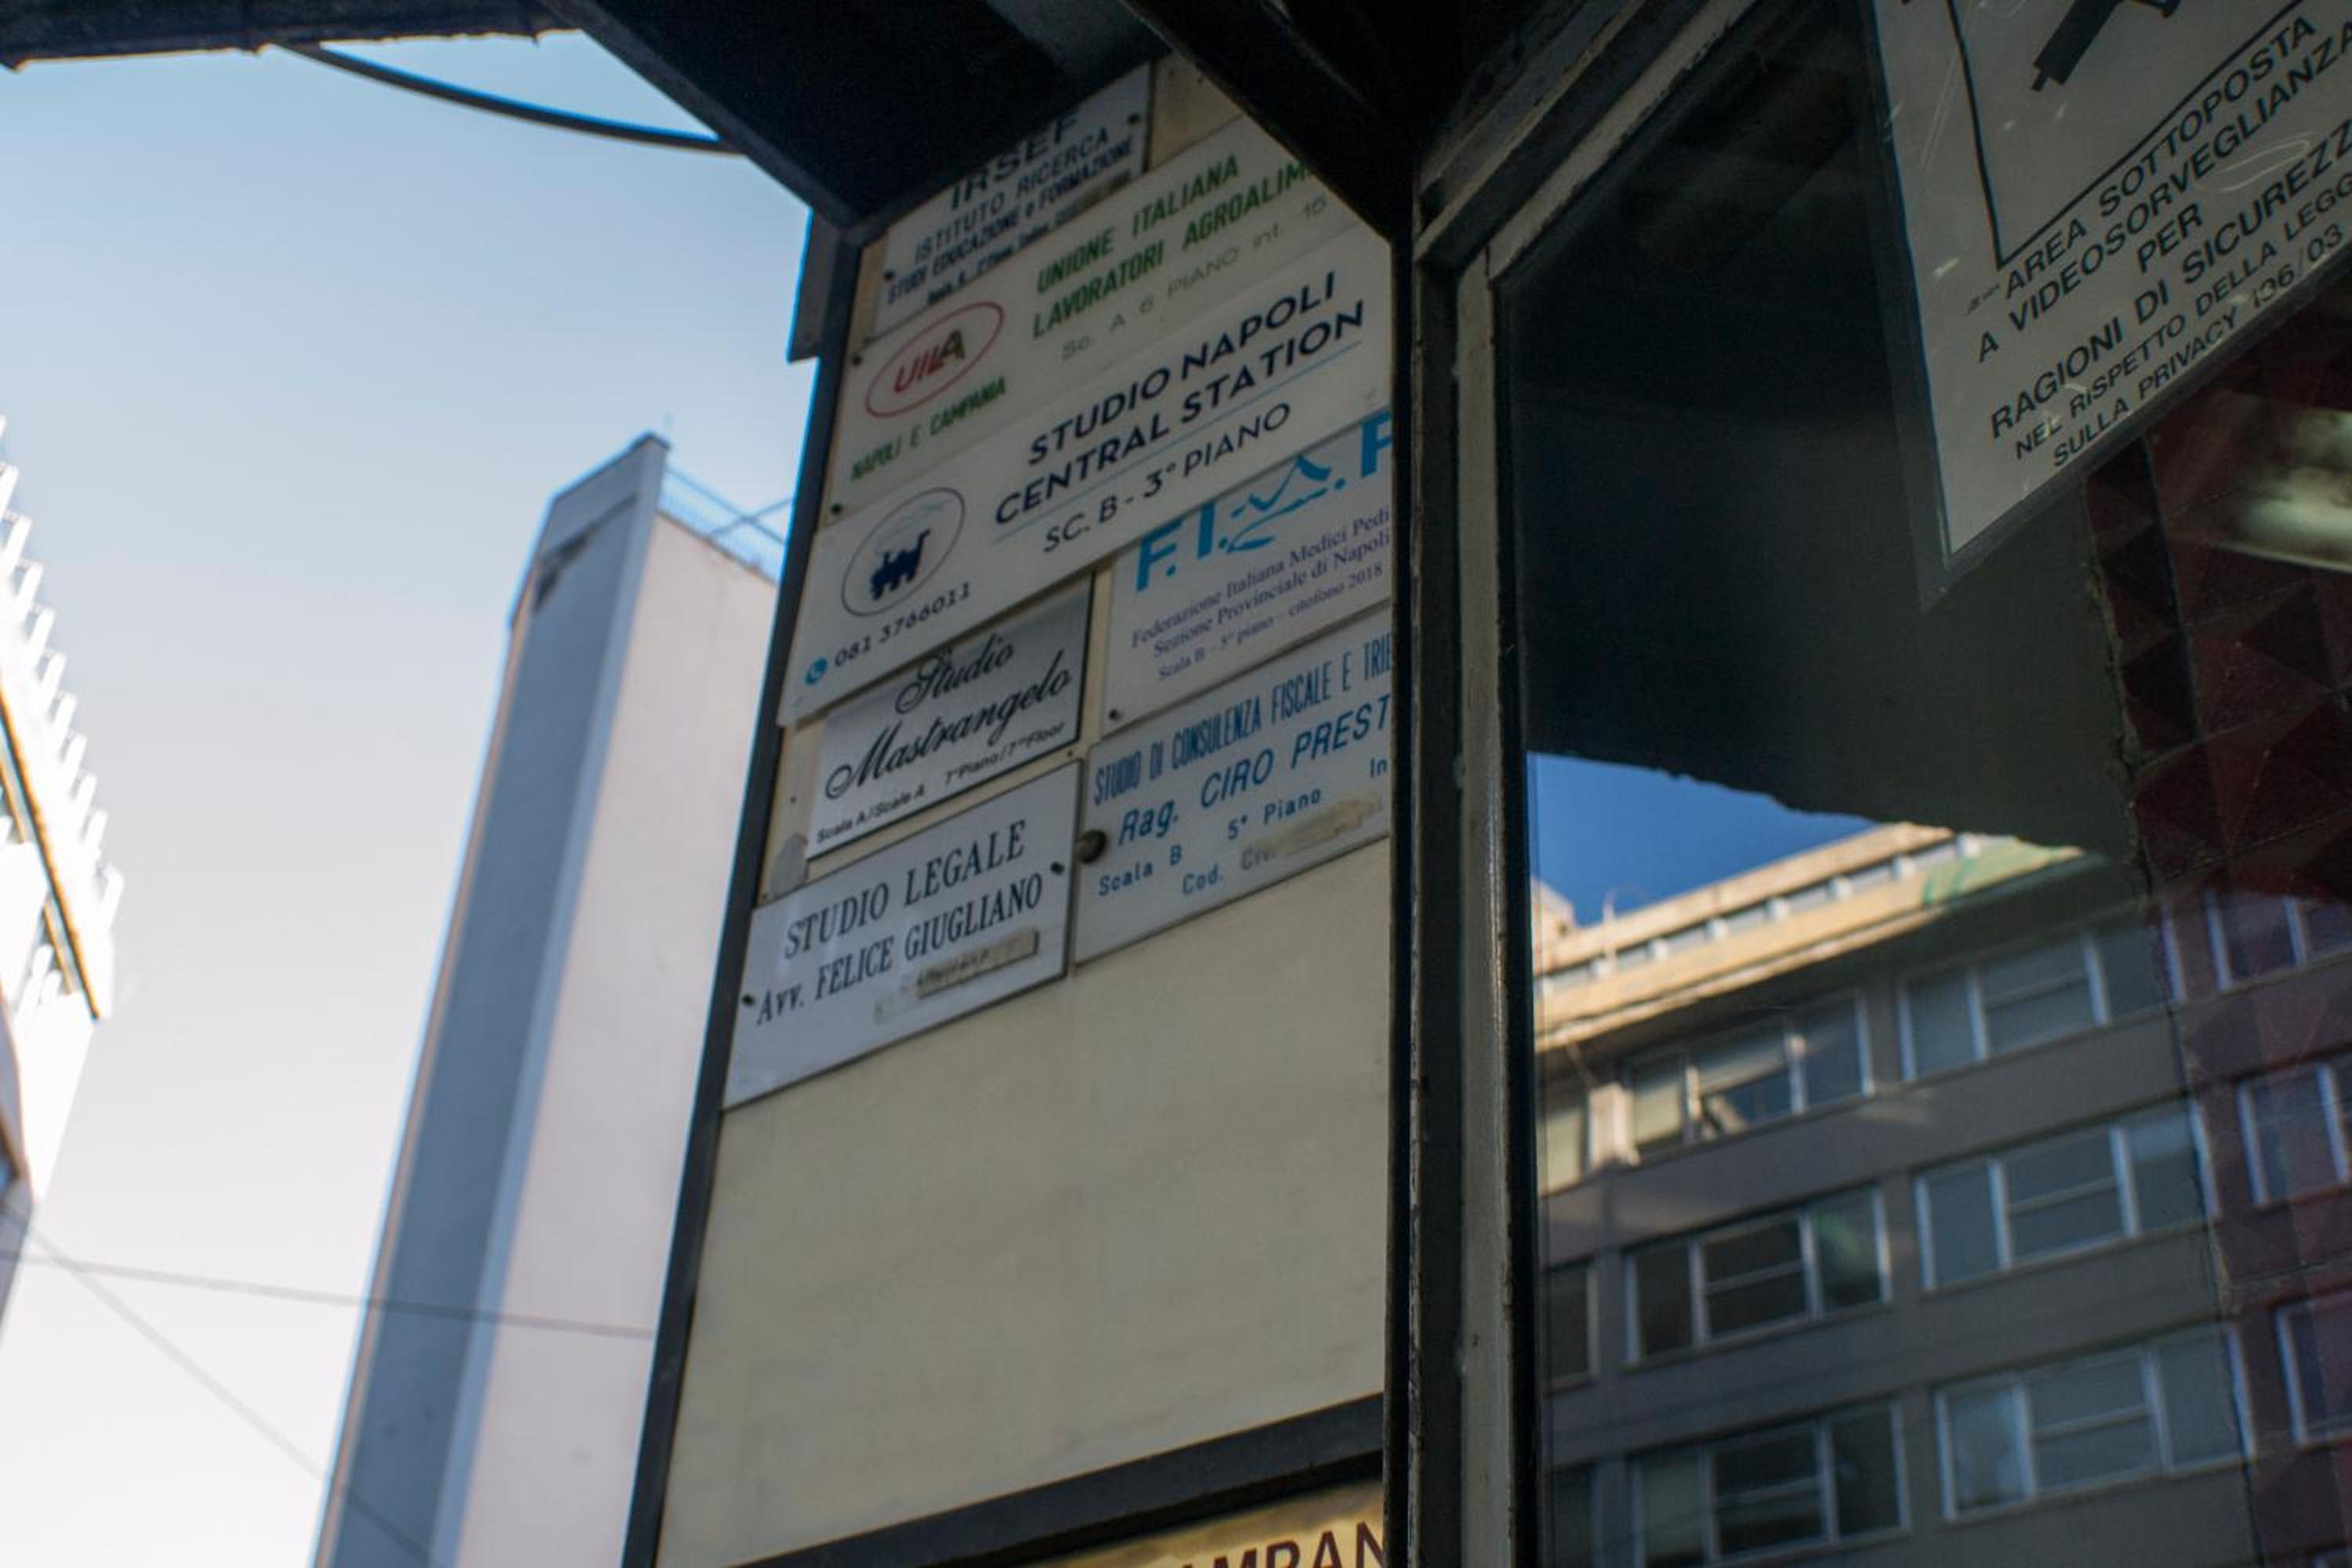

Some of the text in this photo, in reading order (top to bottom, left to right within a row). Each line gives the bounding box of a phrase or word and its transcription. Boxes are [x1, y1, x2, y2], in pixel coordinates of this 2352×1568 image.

[916, 192, 1004, 263] ISTITUTO
[1017, 128, 1108, 198] RICERCA
[2006, 16, 2316, 299] AREA SOTTOPOSTA
[1037, 227, 1115, 293] UNIONE
[1132, 153, 1238, 238] ITALIANA
[1168, 245, 1241, 298] PIANO
[1991, 118, 2352, 439] RAGIONI DI SICUREZZ
[2136, 202, 2204, 273] PER
[1033, 239, 1164, 339] LAVORATORI
[1978, 332, 2000, 364] A
[2016, 416, 2063, 461] NEL
[2069, 314, 2187, 419] RISPETTO
[2195, 242, 2277, 317] DELLA
[852, 376, 1005, 480] NAPOLI E CAMPANIA
[995, 299, 1363, 524] CENTRAL STATION
[1029, 271, 1334, 466] STUDIO NAPOLI
[2053, 397, 2132, 468] SULLA
[2138, 306, 2240, 400] PRIVACY
[1044, 513, 1091, 552] SC.
[1185, 402, 1291, 478] PIANO
[1131, 590, 1221, 648] Federazione
[1225, 561, 1286, 600] Italiana
[1289, 529, 1348, 566] Medici
[1153, 528, 1390, 658] Sezione Provinciale di Napoli
[1347, 563, 1384, 590] 2018
[834, 636, 871, 666] 081
[894, 632, 1014, 714] Studio
[825, 648, 1072, 800] Mastrangelo
[1094, 750, 1142, 806] STUDIO
[1149, 740, 1164, 781] DI
[1171, 695, 1261, 770] CONSULENZA
[1271, 661, 1332, 725] FISCALE
[1342, 652, 1352, 692] E
[1118, 694, 1391, 846] Rag. CIRO PREST
[784, 819, 1026, 960] STUDIO LEGALE
[816, 818, 854, 844] Scala
[1098, 862, 1153, 897] Scala
[1169, 844, 1182, 866] B
[1265, 789, 1321, 825] Piano
[1182, 864, 1224, 895] Cod.
[815, 935, 895, 1001] FELICE
[905, 872, 1044, 962] GIUGLIANO
